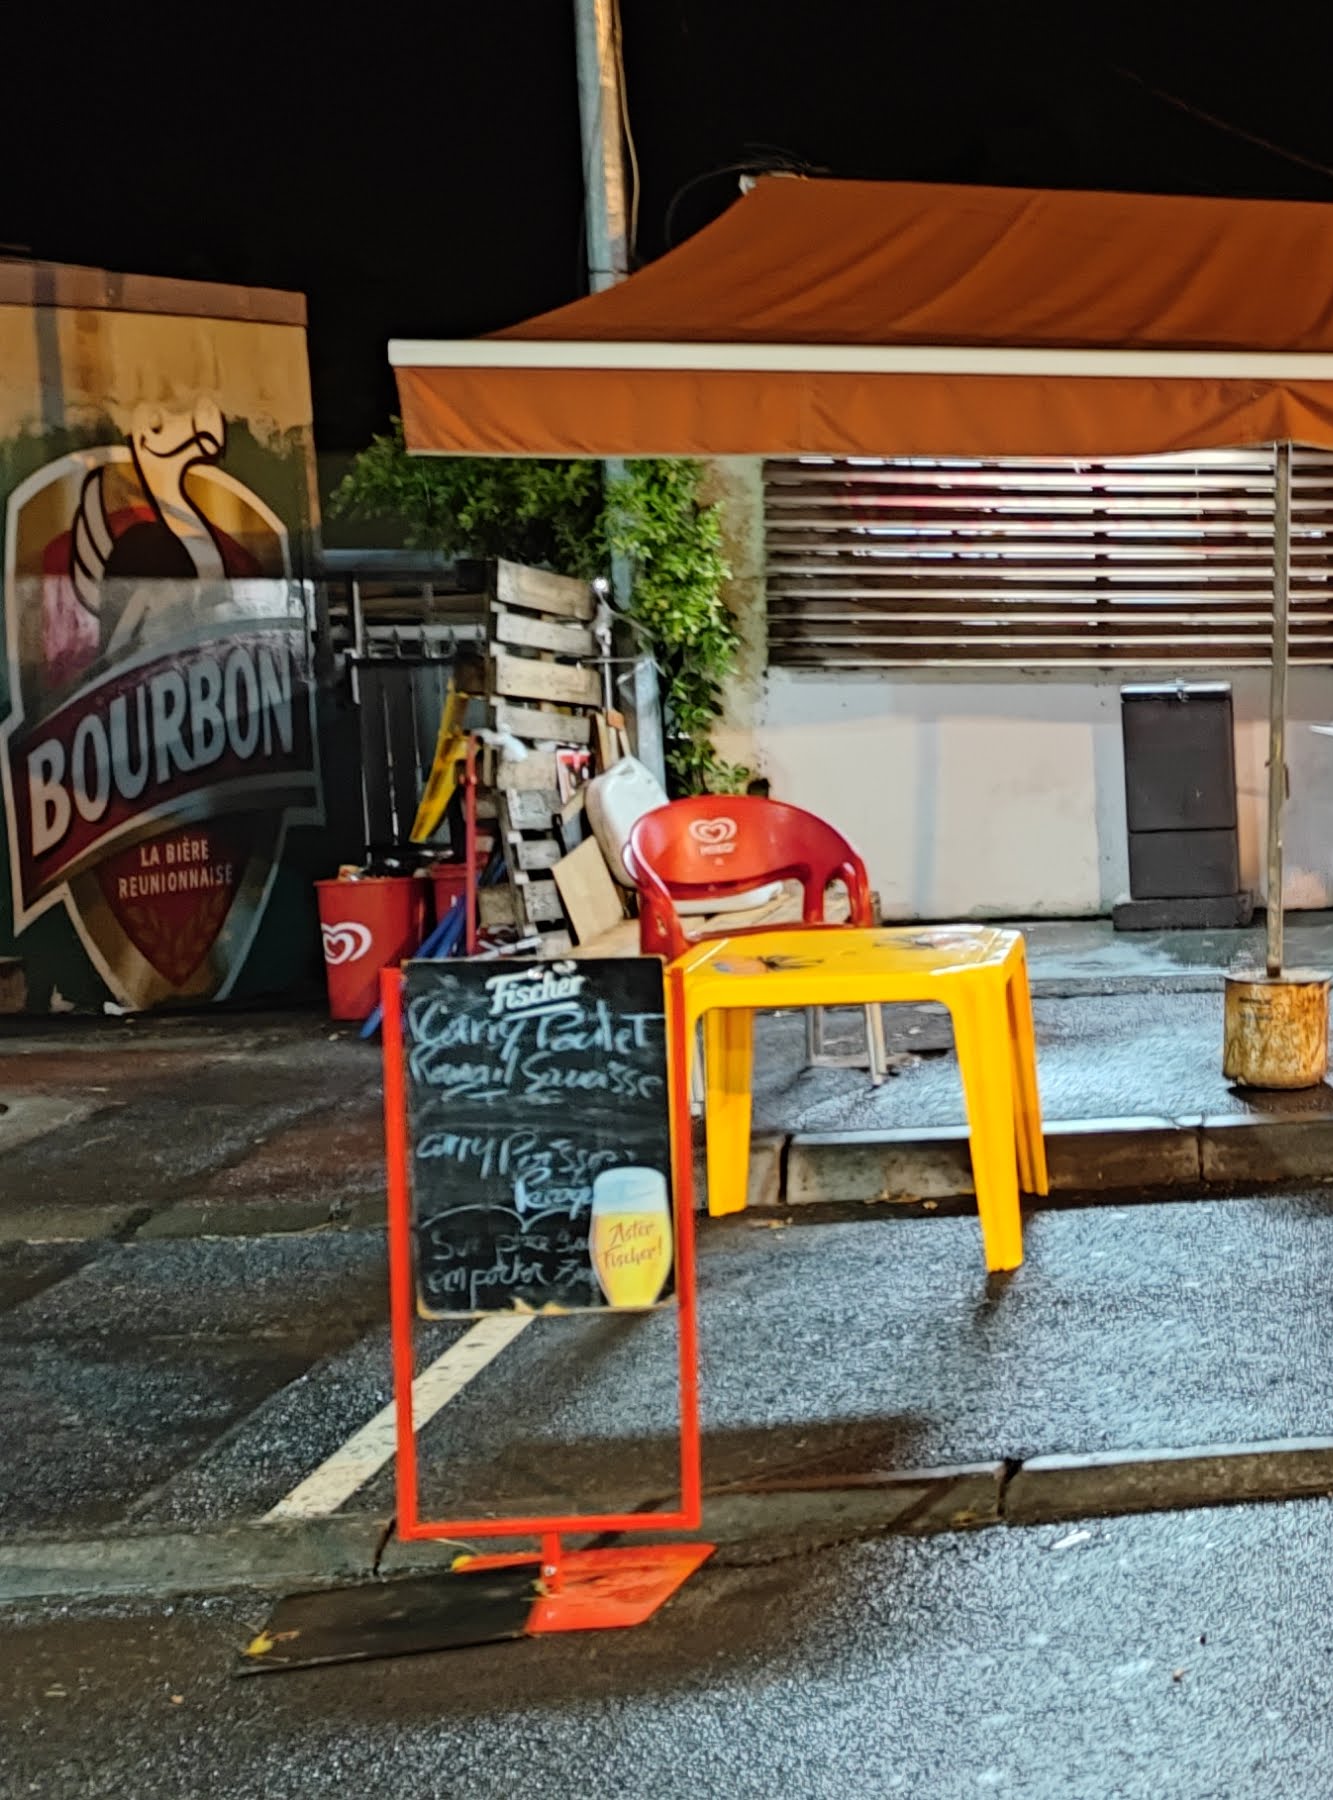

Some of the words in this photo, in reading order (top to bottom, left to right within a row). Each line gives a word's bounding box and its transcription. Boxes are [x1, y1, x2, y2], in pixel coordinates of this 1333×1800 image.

[27, 645, 294, 858] BOURBON
[140, 846, 161, 868] LA
[166, 835, 210, 864] BIÈRE
[118, 863, 233, 900] REUNIONNAISE
[485, 966, 588, 1016] Fischer
